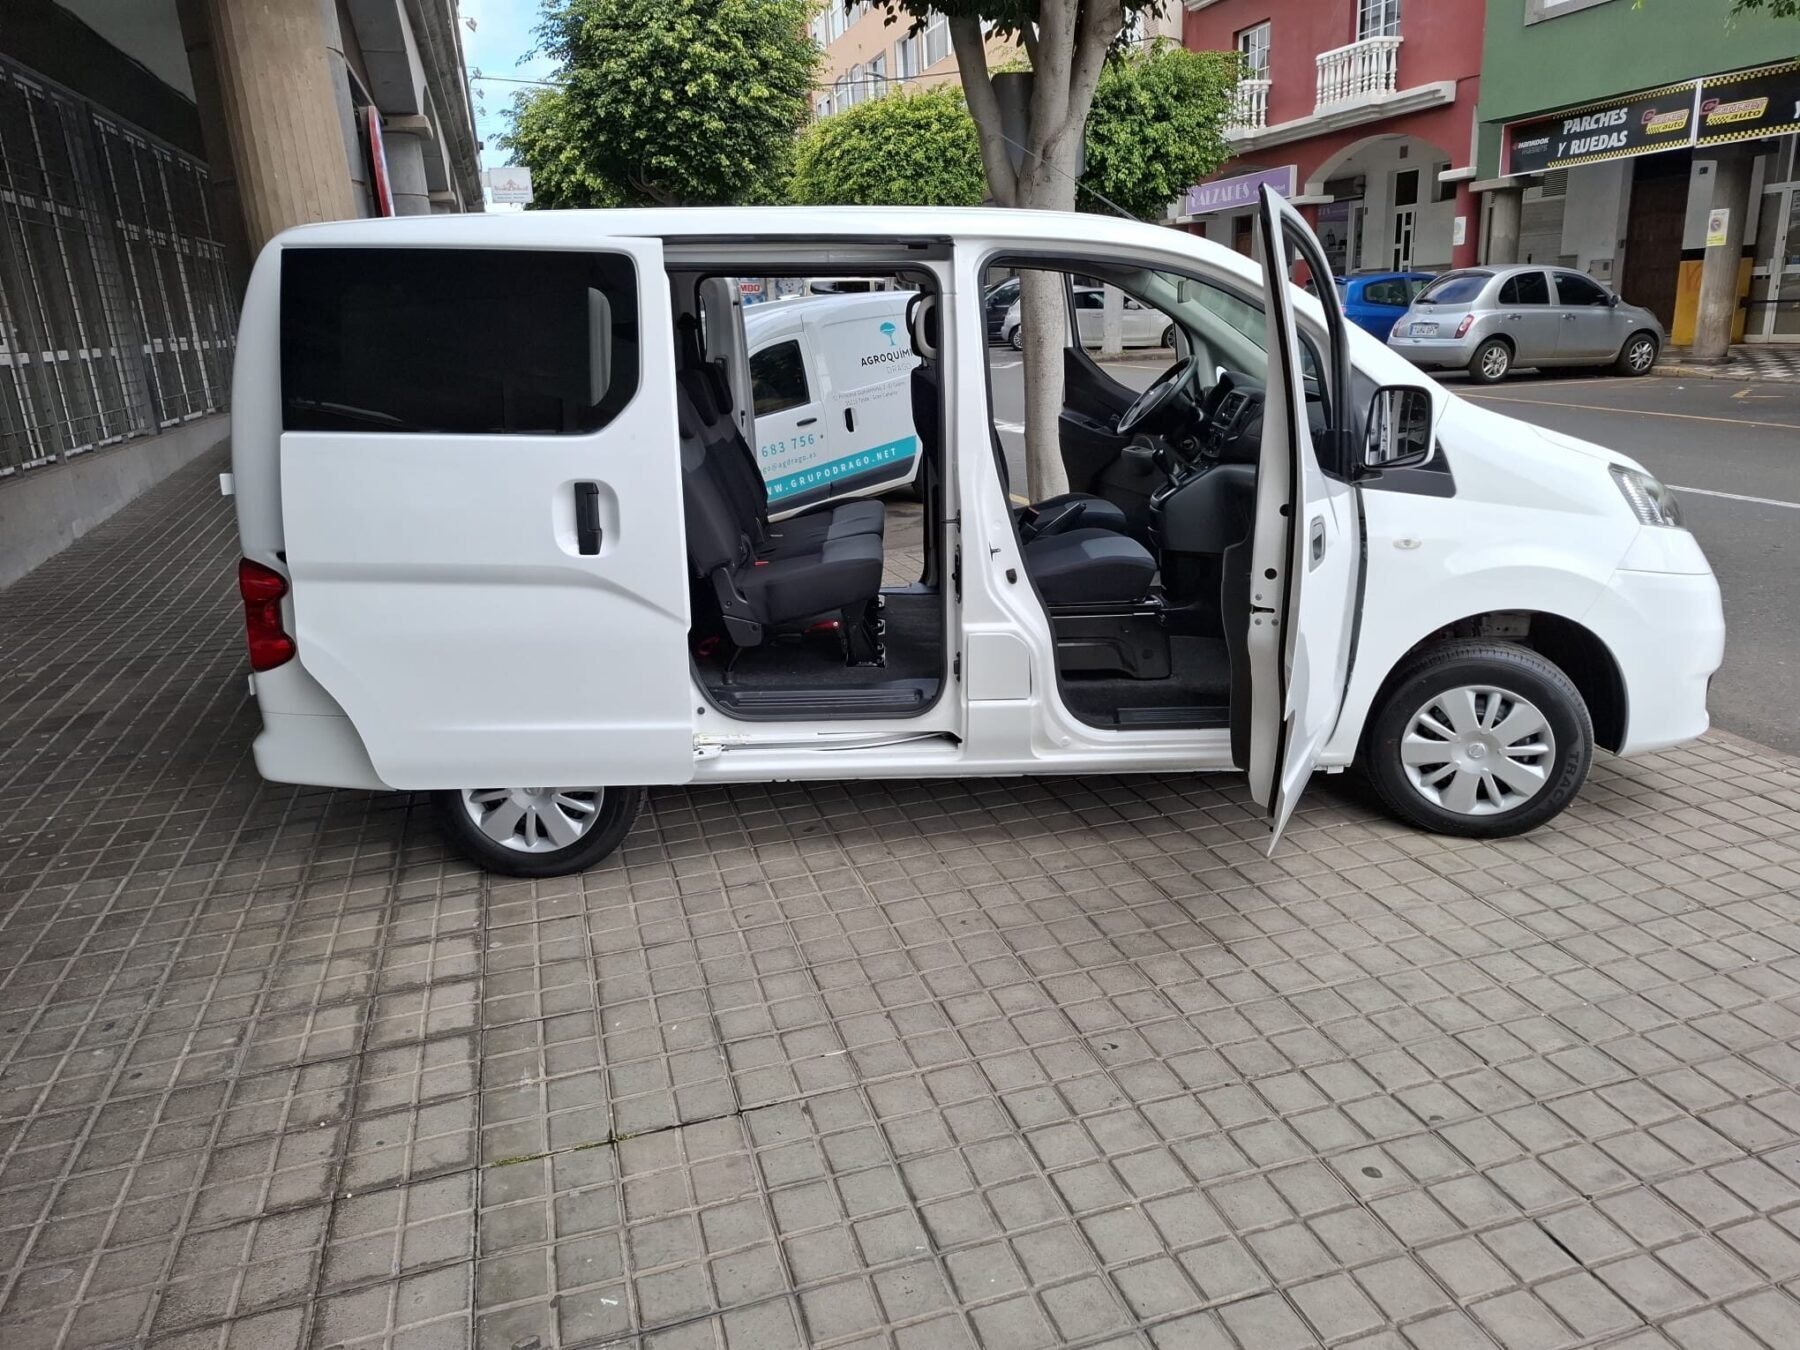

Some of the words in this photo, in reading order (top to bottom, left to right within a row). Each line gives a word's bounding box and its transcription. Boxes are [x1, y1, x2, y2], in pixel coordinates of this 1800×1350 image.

[1563, 107, 1628, 135] PARCHES
[1661, 121, 1684, 130] auto
[1730, 110, 1761, 121] auto
[1557, 142, 1567, 157] Y
[1569, 130, 1628, 155] RUEDAS
[761, 442, 785, 458] 683
[791, 434, 815, 450] 756
